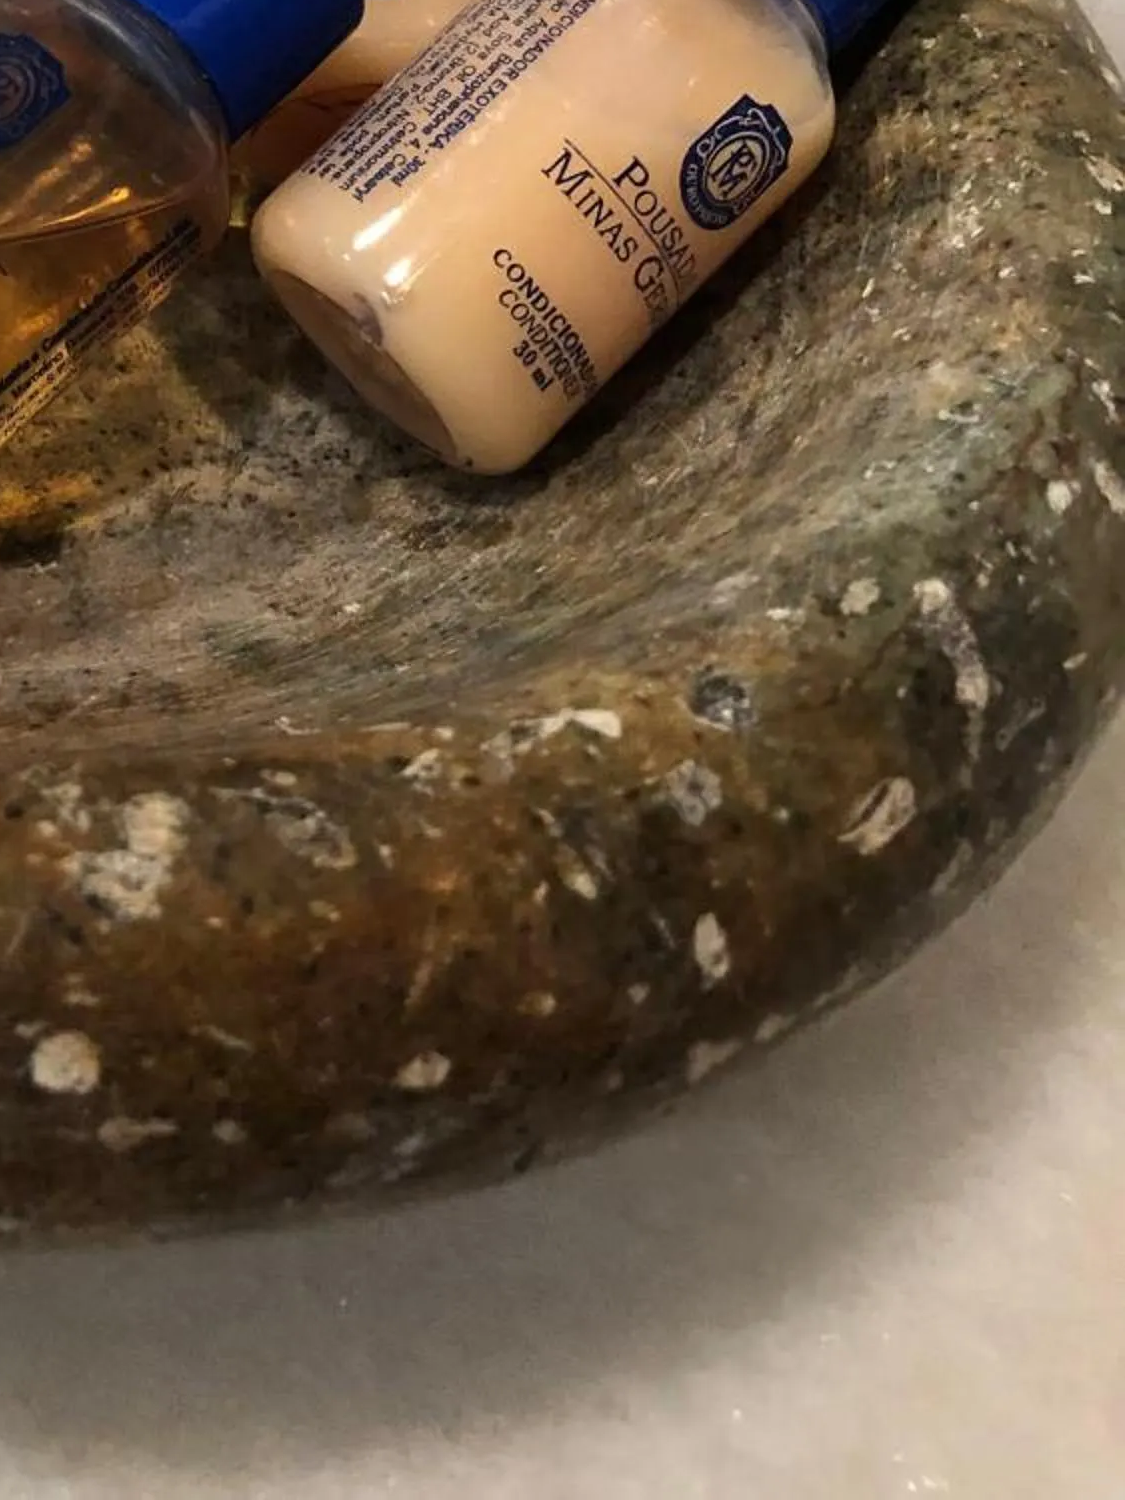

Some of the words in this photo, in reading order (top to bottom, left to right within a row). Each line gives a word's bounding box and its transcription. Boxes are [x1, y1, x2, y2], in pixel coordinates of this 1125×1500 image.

[541, 147, 639, 262] MINAS
[613, 155, 696, 279] POUSAD
[513, 339, 537, 366] 30
